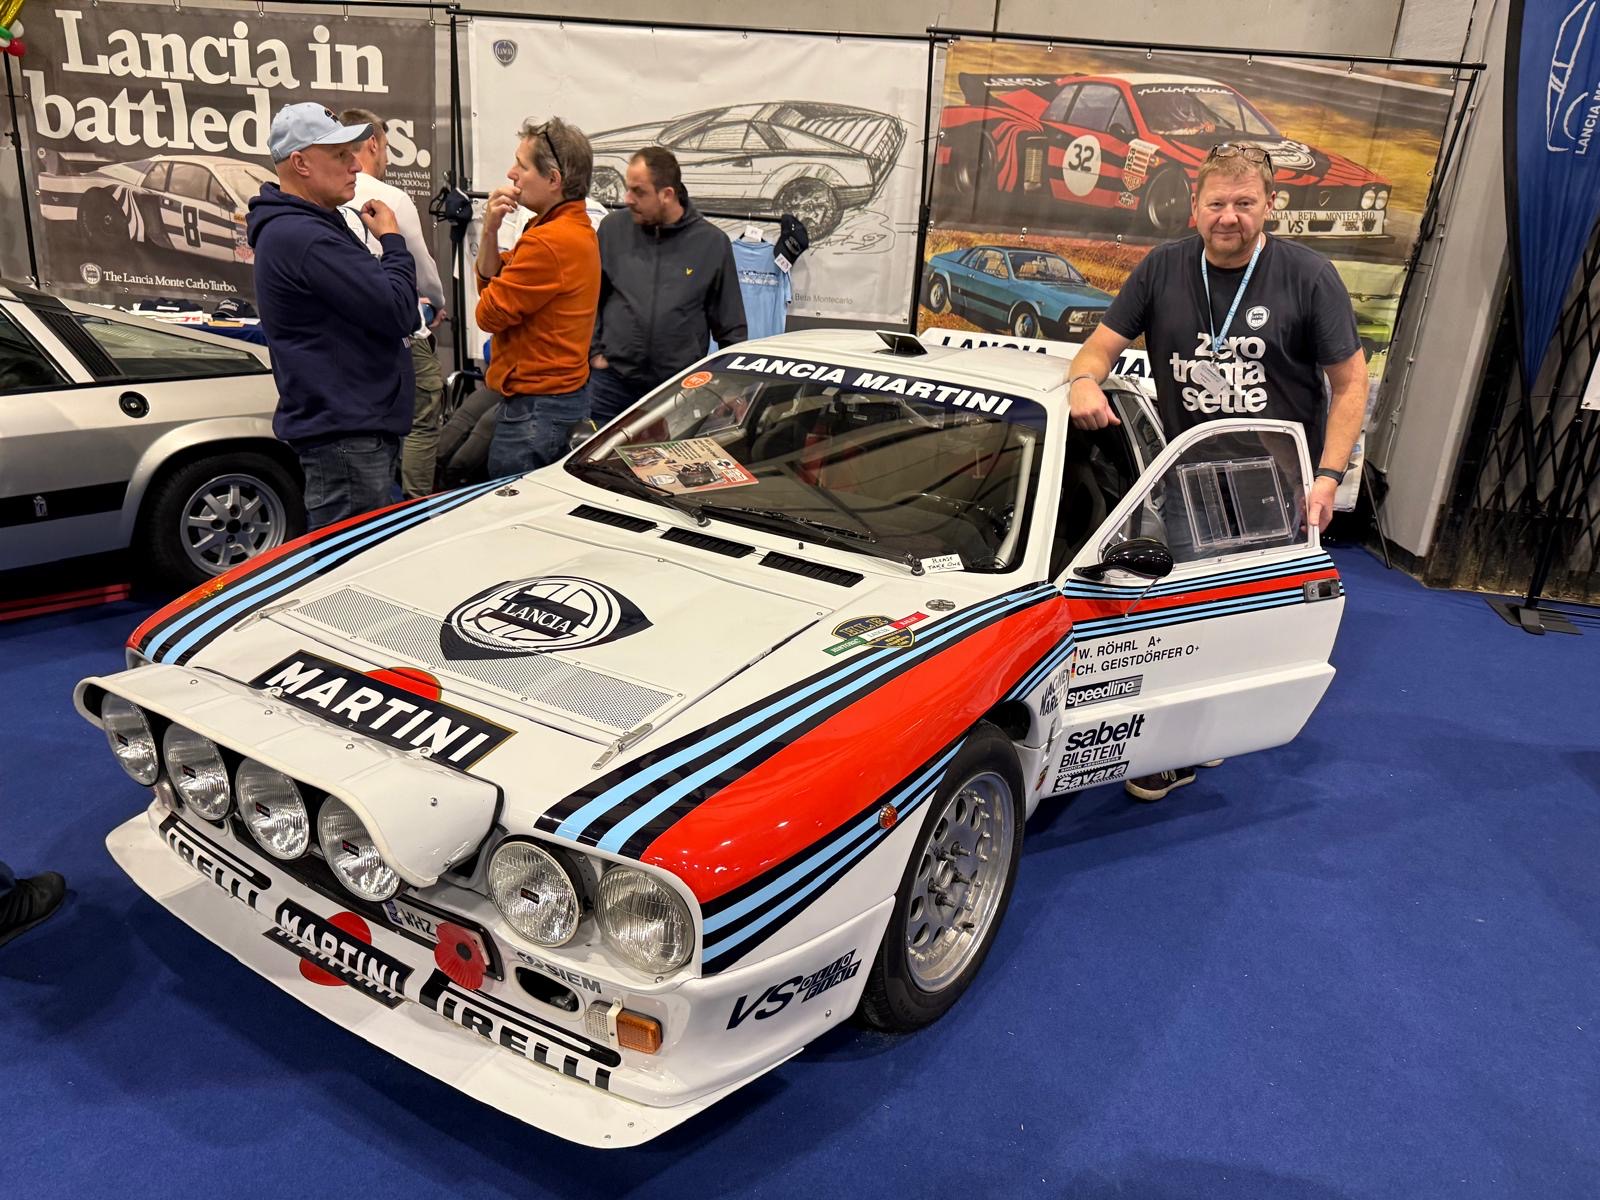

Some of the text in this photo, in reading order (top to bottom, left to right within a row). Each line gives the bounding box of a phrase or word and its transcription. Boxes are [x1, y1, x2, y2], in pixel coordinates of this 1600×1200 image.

[55, 9, 388, 93] Lancia in
[1138, 86, 1234, 96] pininfarina
[23, 70, 431, 168] battleds.
[1575, 105, 1600, 154] LANCIA
[1068, 143, 1094, 172] 32
[412, 171, 431, 180] World
[183, 205, 201, 248] 8
[1288, 220, 1304, 234] VS
[1298, 211, 1317, 220] BETA
[103, 271, 237, 293] The Lancia Monte Carlo Turbo.
[795, 293, 853, 305] Beta Montecarlo
[726, 356, 1014, 416] LANCIA MARTINI
[1182, 382, 1268, 414] sette
[501, 602, 571, 633] LANCIA
[1076, 644, 1200, 676] CH. GEISTDÖRFER O+
[1079, 635, 1162, 660] W. RÖHRL A+
[1067, 681, 1135, 707] speedline
[264, 661, 490, 763] MARTINI
[1065, 714, 1145, 751] sabelt
[1060, 742, 1127, 768] BILSTEIN
[166, 820, 260, 910] PIRELLI
[275, 908, 401, 999] MARTINI
[544, 963, 602, 994] SIEM
[800, 952, 852, 990] OLIO
[805, 963, 860, 1000] FIAT
[726, 975, 803, 1030] VS
[436, 981, 612, 1091] PIRELLI
